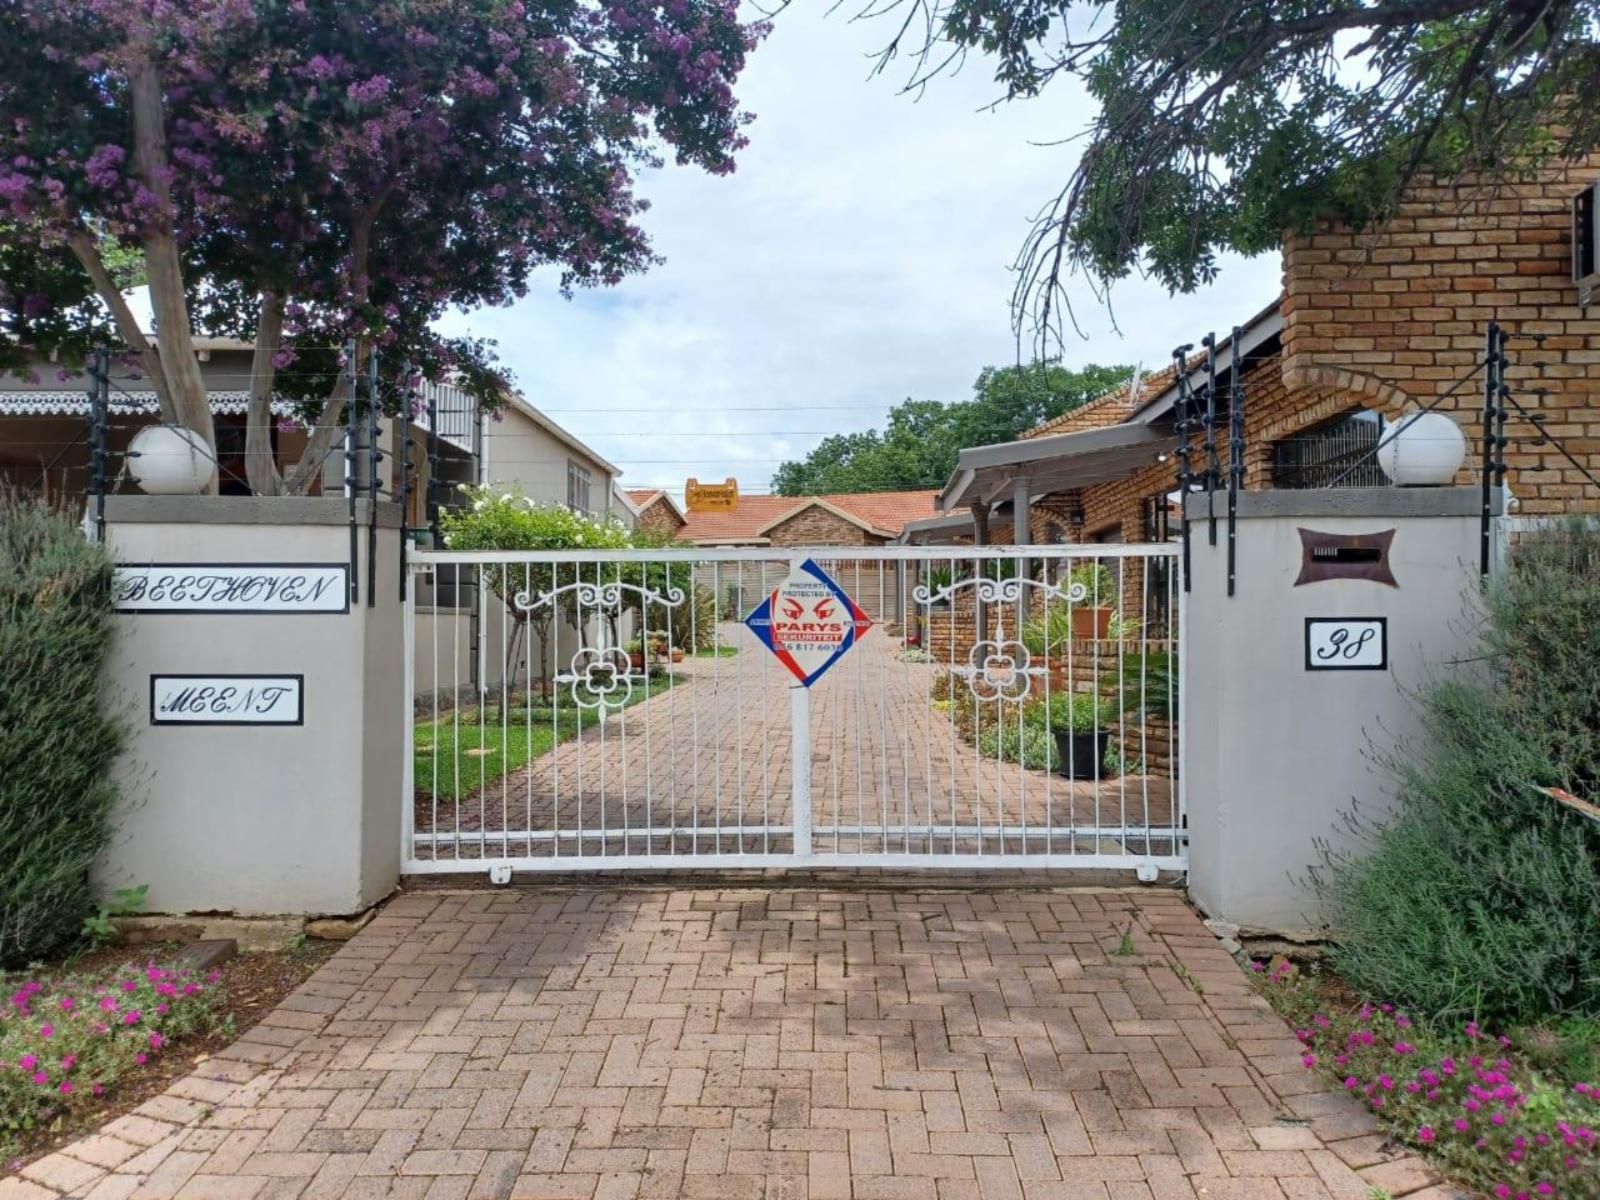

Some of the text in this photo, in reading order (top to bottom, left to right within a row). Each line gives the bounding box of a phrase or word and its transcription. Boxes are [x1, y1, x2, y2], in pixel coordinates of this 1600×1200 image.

[119, 575, 338, 602] BEETHOVEN
[776, 623, 842, 631] PARYS
[1317, 628, 1375, 659] 38
[159, 687, 294, 713] MEENT
